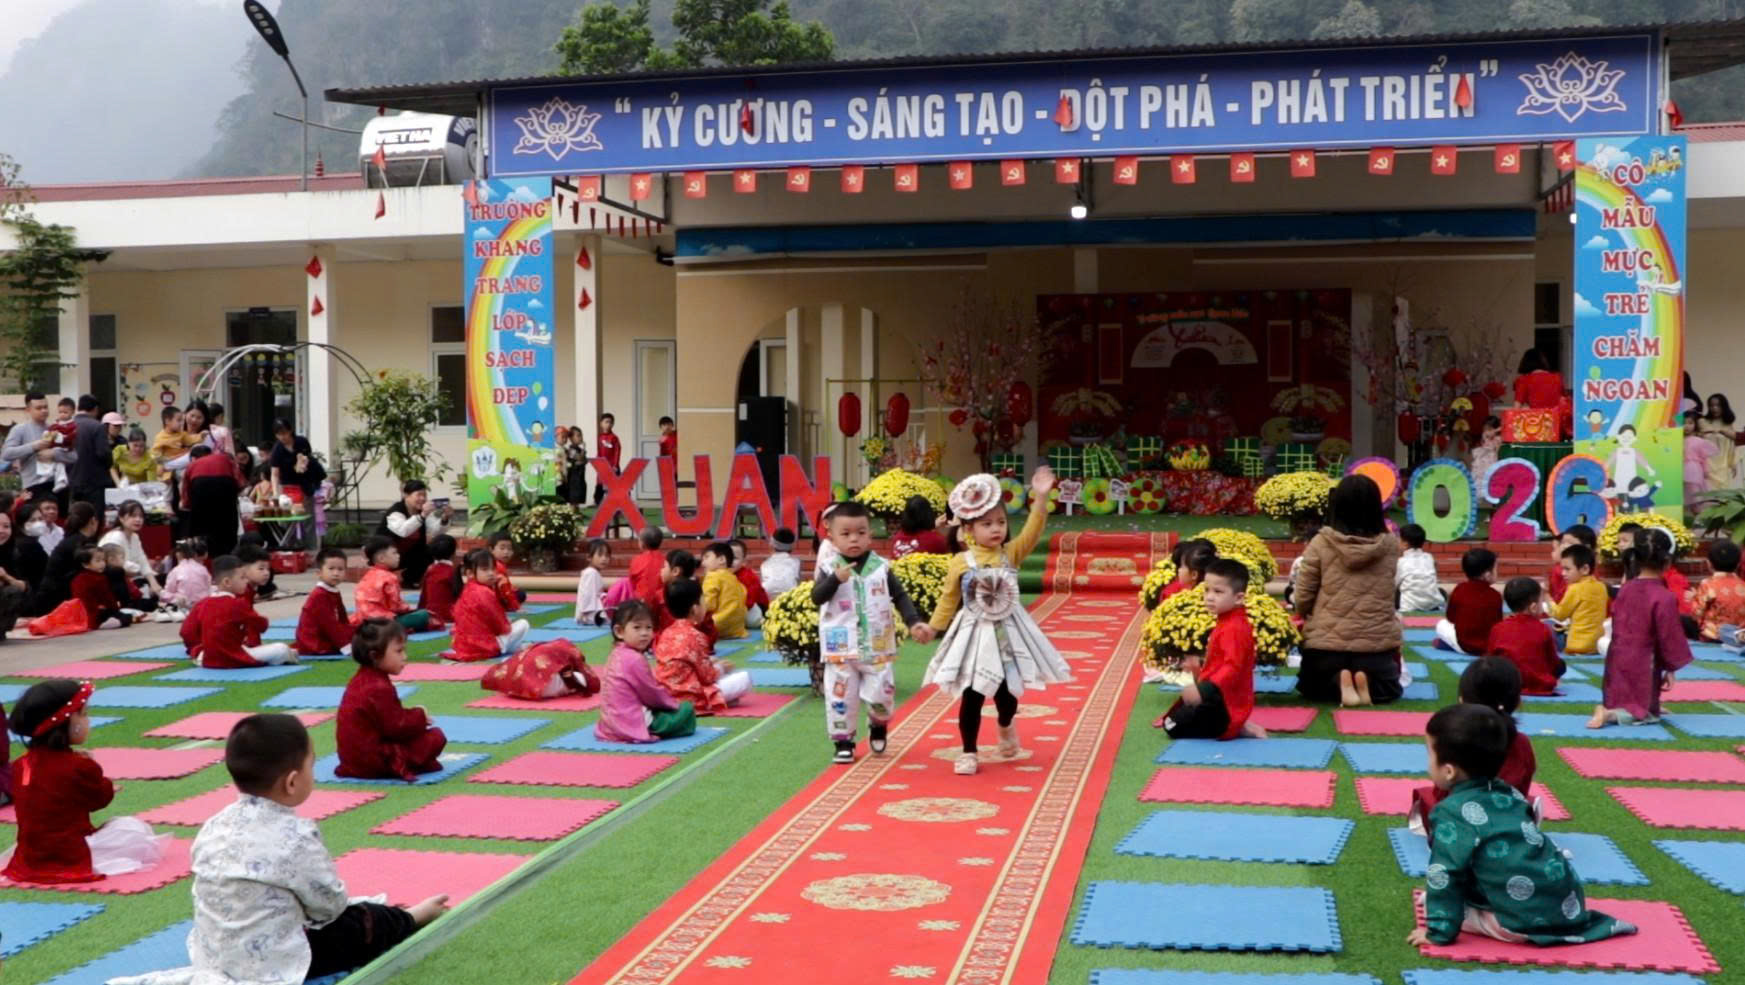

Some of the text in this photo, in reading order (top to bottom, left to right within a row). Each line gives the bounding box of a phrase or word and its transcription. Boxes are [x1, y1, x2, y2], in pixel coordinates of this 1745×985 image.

[694, 97, 814, 147] CƯƠNG
[847, 87, 945, 141] SÁNG
[955, 90, 1024, 145] TẠO
[1140, 73, 1216, 129] PHÁ
[1251, 69, 1350, 125] PHÁT
[1614, 158, 1644, 185] CÔ
[1602, 197, 1654, 228] MẪU
[475, 239, 541, 257] KHANG
[1603, 248, 1653, 276] MỰC
[476, 276, 541, 294] TRANG
[1605, 285, 1649, 314] TRẺ
[1594, 331, 1660, 357] CHĂM
[485, 350, 534, 372] SẠCH
[1586, 379, 1668, 401] NGOAN
